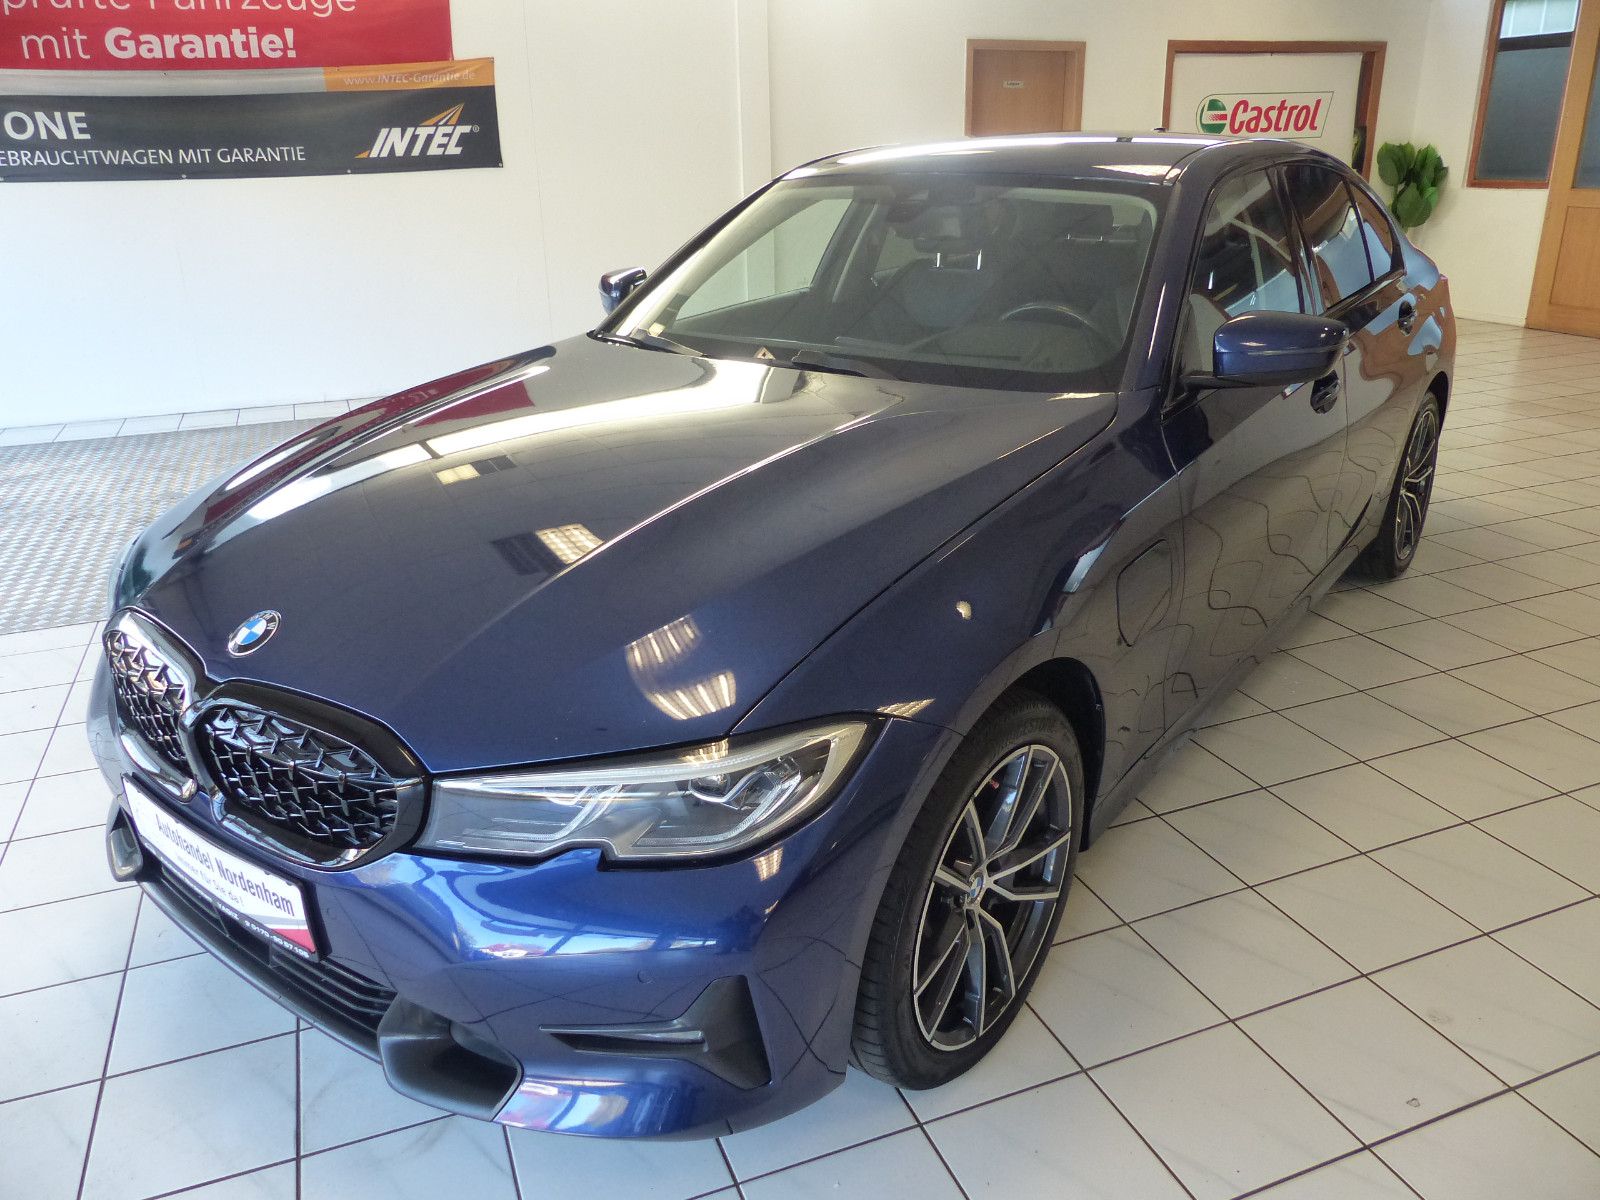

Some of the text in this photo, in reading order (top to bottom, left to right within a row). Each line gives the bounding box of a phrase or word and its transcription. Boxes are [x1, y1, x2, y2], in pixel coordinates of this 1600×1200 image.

[21, 26, 297, 60] mit Garantie!
[343, 69, 477, 86] www.INTEC-Garantie.de
[3, 110, 91, 141] ONE
[1229, 98, 1322, 135] Castrol
[178, 149, 211, 164] MIT
[217, 146, 306, 163] GARANTIE
[155, 813, 214, 873] Autohandel
[214, 856, 295, 917] Nordenham
